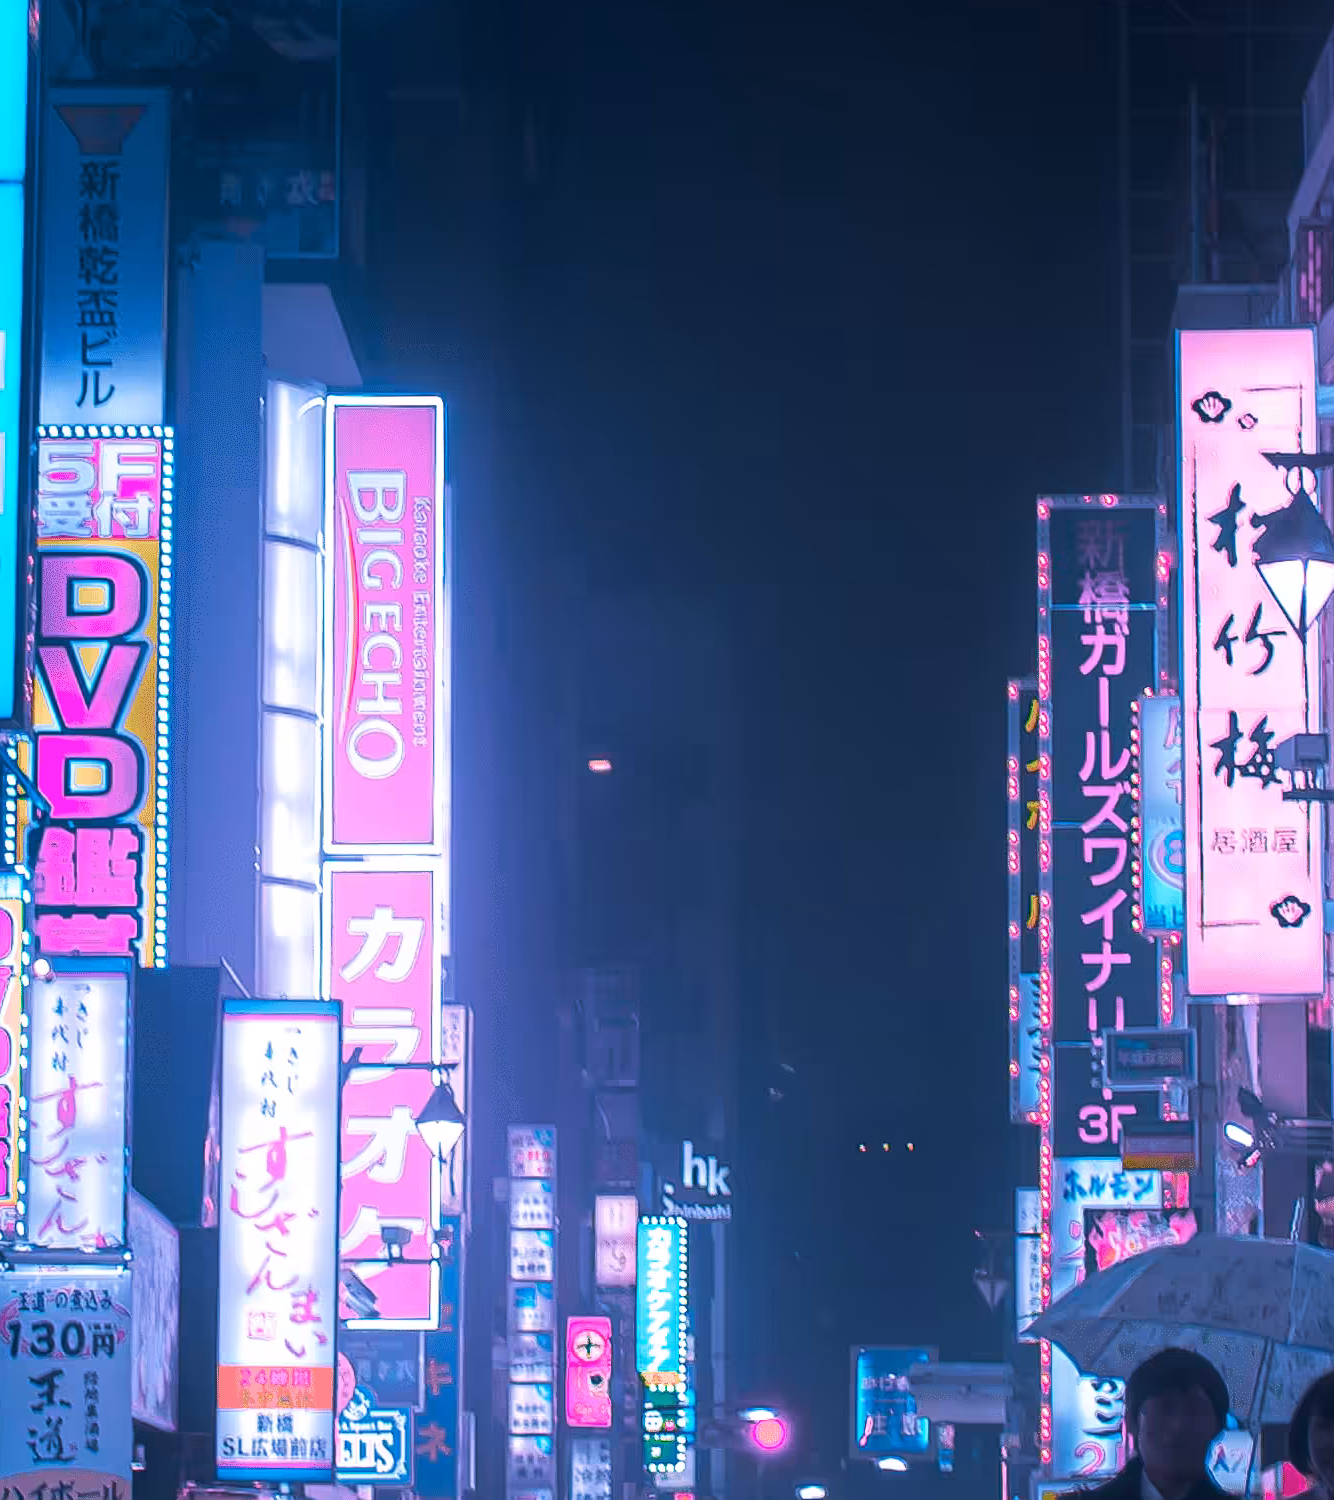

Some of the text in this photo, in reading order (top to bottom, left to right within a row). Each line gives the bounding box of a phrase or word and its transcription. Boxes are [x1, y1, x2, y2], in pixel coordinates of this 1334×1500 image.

[38, 442, 158, 494] 5F
[347, 468, 408, 780] BIG ECHO
[1211, 827, 1300, 856] 居酒屋
[8, 1320, 116, 1358] 130円
